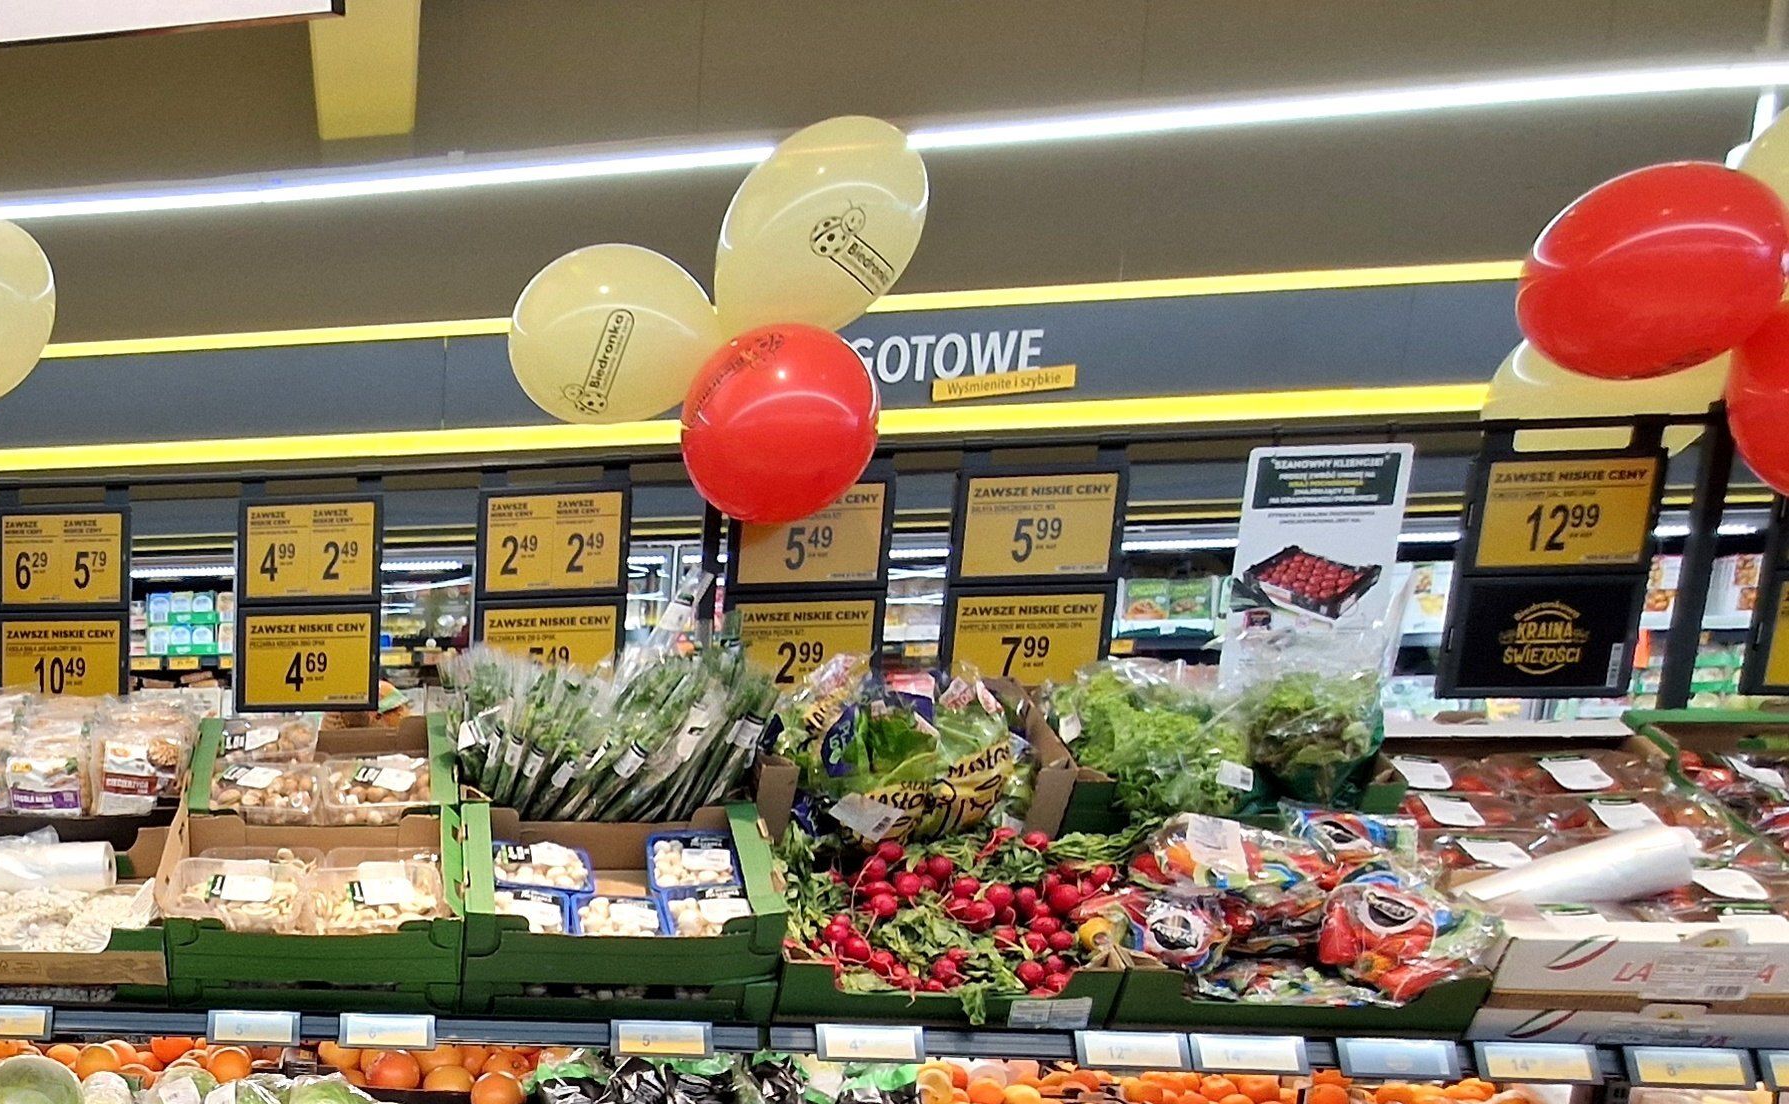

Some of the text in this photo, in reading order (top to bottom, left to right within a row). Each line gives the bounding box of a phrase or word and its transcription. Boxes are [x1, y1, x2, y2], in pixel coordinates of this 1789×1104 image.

[589, 314, 624, 388] Biedronka
[947, 377, 1012, 396] Wyśmienite
[1021, 372, 1061, 392] szybkie
[974, 484, 1111, 498] ZAWSZE NISKIE CENY
[557, 500, 594, 508] ZAWSZE
[845, 494, 879, 504] CENY
[491, 503, 528, 511] ZAWSZE
[251, 511, 286, 519] ZAWSZE
[313, 509, 348, 517] ZAWSZE
[794, 610, 832, 621] NISKIE
[835, 610, 868, 620] CENY
[962, 604, 1098, 617] ZAWSZE NISKIE CENY
[489, 616, 611, 628] ZAWSZE NISKIE CENY
[7, 629, 115, 639] ZAWSZE NISKIE CENY
[250, 623, 366, 634] ZAWSZE NISKIE CENY
[1516, 621, 1573, 640] KRAINA
